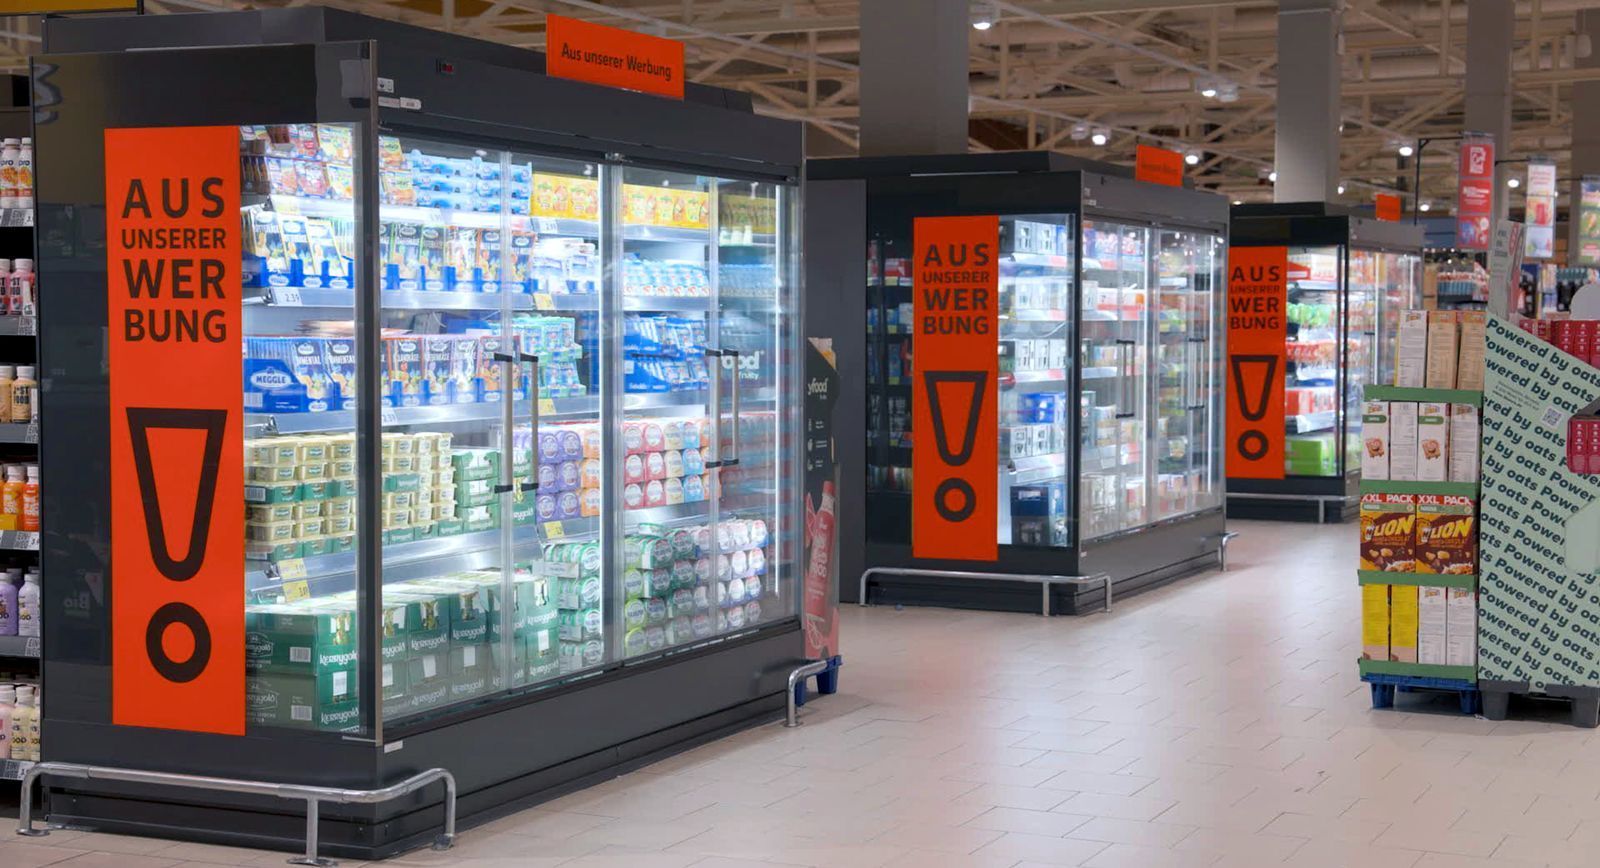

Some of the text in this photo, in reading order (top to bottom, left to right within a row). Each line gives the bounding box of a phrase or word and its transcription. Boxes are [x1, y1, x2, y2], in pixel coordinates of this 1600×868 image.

[561, 42, 671, 81] Aus unserer Werbung
[122, 177, 225, 219] AUS
[122, 227, 226, 249] UNSERER
[923, 243, 989, 267] AUS
[123, 259, 226, 299] WER
[922, 271, 990, 284] UNSERER
[1231, 265, 1280, 282] AUS
[923, 288, 989, 311] WER
[1231, 284, 1280, 294] UNSERER
[1231, 297, 1279, 313] WER
[124, 309, 226, 343] BUNG
[923, 315, 989, 335] BUNG
[1230, 316, 1279, 330] BUNG
[1486, 318, 1549, 358] Powered
[1550, 352, 1569, 371] by
[256, 375, 286, 384] MEGGLE
[1485, 336, 1539, 373] owered
[1541, 367, 1560, 386] by
[1562, 381, 1594, 402] oats
[808, 377, 829, 396] yfood
[1531, 382, 1550, 401] by
[1553, 396, 1580, 414] oat
[1513, 412, 1532, 430] by
[1534, 426, 1566, 447] oats
[1503, 426, 1523, 444] by
[1525, 441, 1557, 462] oats
[1495, 441, 1514, 459] by
[1516, 455, 1547, 476] oats
[1485, 455, 1504, 473] by
[1507, 470, 1538, 491] oats
[1386, 494, 1414, 503] PACK
[1417, 495, 1440, 504] XXL
[1498, 484, 1529, 505] oats
[1489, 498, 1520, 520] oats
[1374, 514, 1415, 537] LION
[1430, 516, 1473, 539] LION
[1504, 543, 1567, 584] Powered
[1567, 580, 1587, 599] by
[1495, 558, 1558, 599] Powered
[1558, 594, 1578, 613] by
[1486, 572, 1548, 613] Powered
[1549, 609, 1569, 627] by
[1479, 586, 1594, 660] Powered by oats
[1522, 651, 1541, 670] by
[1531, 637, 1550, 656] by
[1553, 652, 1585, 674] oats
